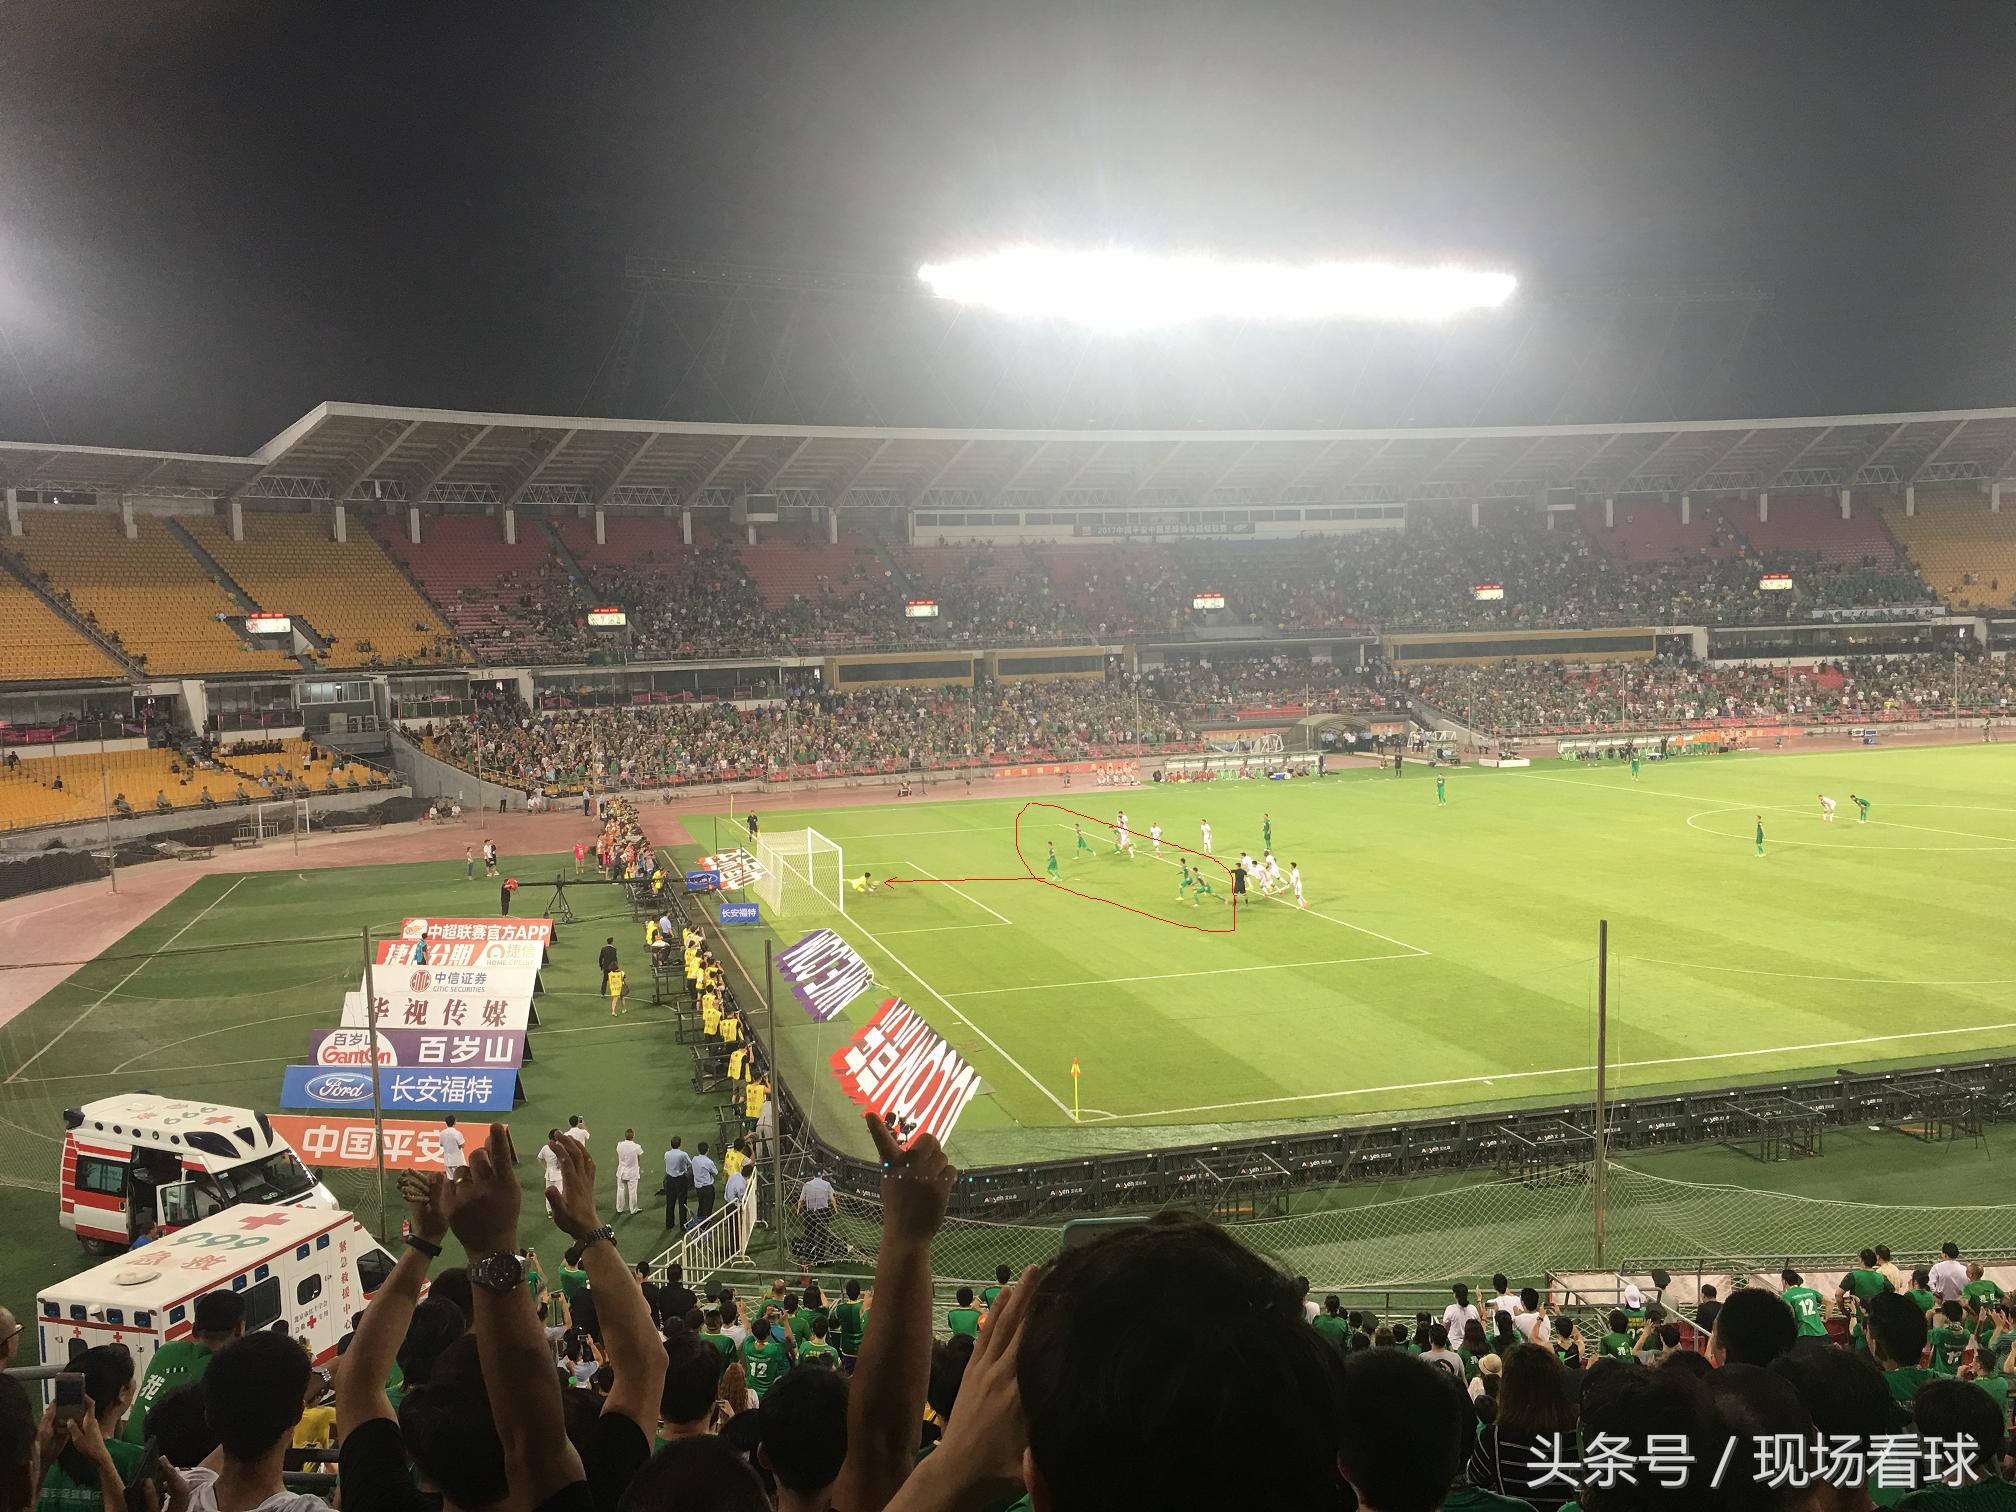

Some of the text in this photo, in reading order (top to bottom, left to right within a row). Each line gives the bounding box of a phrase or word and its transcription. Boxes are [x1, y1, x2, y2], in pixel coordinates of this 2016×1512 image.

[481, 671, 494, 679] 16
[721, 908, 757, 918] 长安福特
[428, 924, 550, 940] 中超联赛官方APP
[385, 943, 475, 966] 捷分期
[434, 971, 488, 985] 中信证券
[366, 997, 509, 1028] 华视传媒
[418, 1036, 514, 1064] 百岁山
[319, 1077, 365, 1098] Ford
[390, 1075, 493, 1104] 长安福特
[302, 1124, 445, 1163] 中国平安
[1798, 1298, 1816, 1316] 12
[749, 1361, 768, 1378] 12
